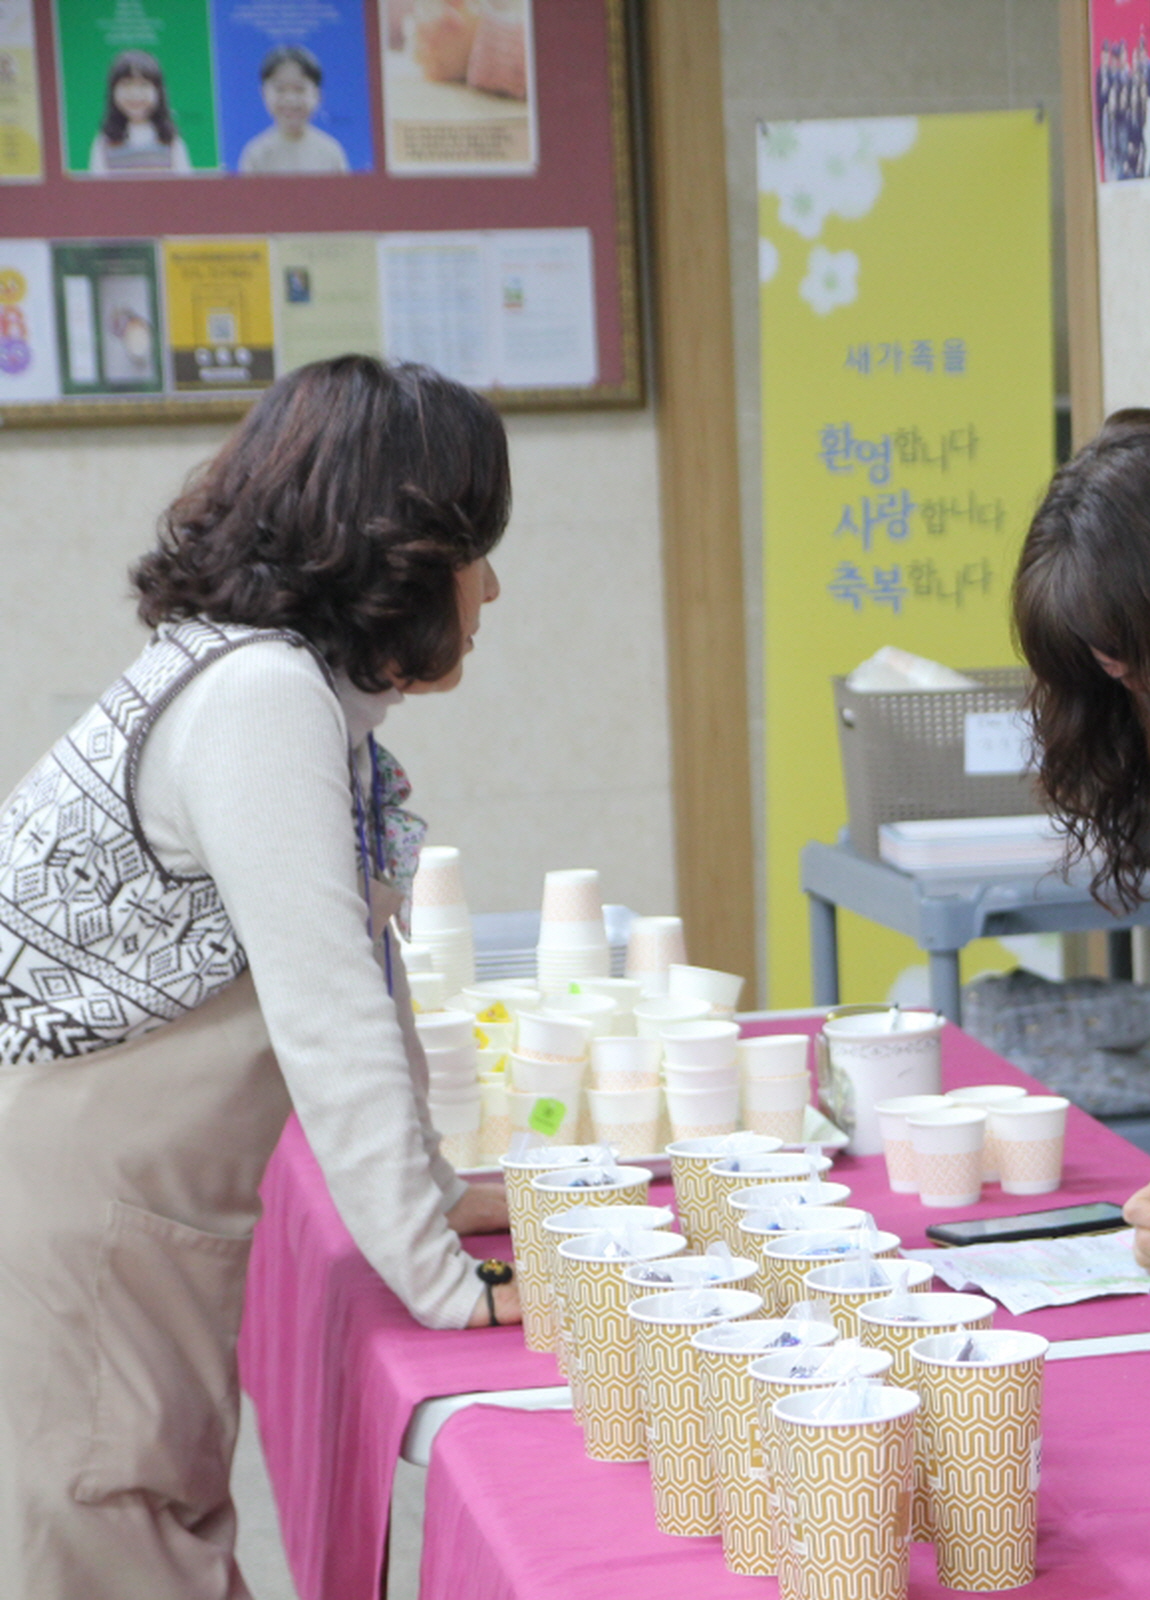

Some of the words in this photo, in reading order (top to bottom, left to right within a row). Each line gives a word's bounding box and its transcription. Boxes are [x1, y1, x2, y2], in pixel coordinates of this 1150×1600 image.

[845, 337, 968, 374] 새가족을
[818, 421, 978, 485] 환영합니다
[833, 488, 1006, 553] 사랑합니다
[827, 557, 993, 615] 축복합니다
